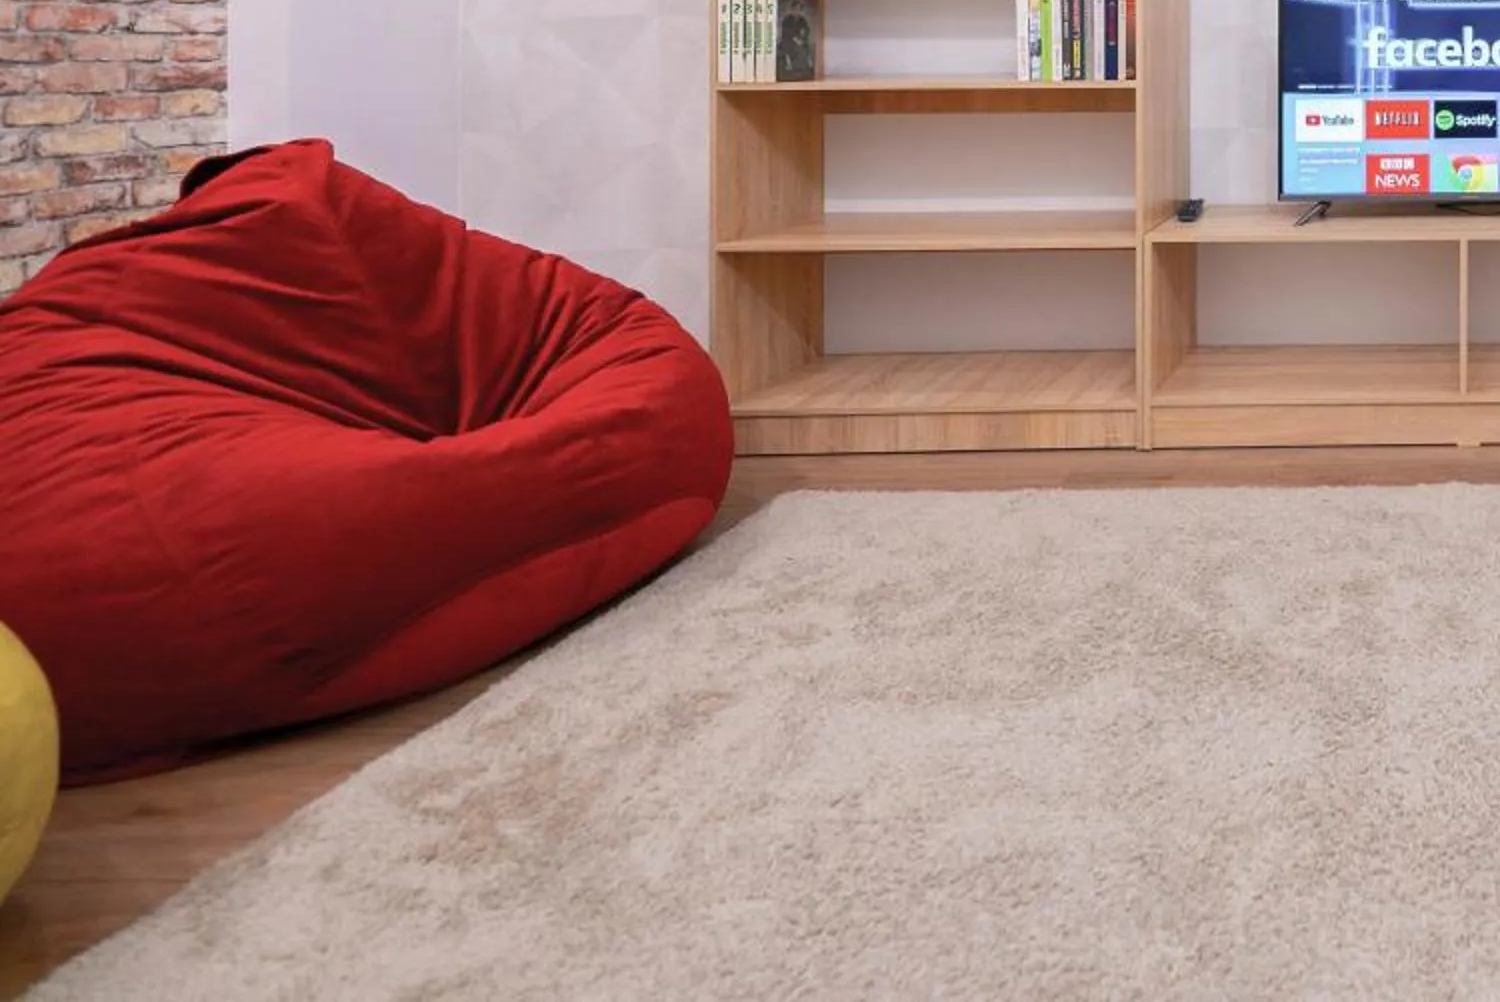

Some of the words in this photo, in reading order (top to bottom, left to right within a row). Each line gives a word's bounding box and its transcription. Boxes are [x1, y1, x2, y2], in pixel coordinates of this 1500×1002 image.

[1323, 114, 1354, 126] YouTube
[1375, 111, 1420, 127] NETFLIX
[1456, 113, 1496, 128] Spotify
[1375, 174, 1420, 188] NEWS
